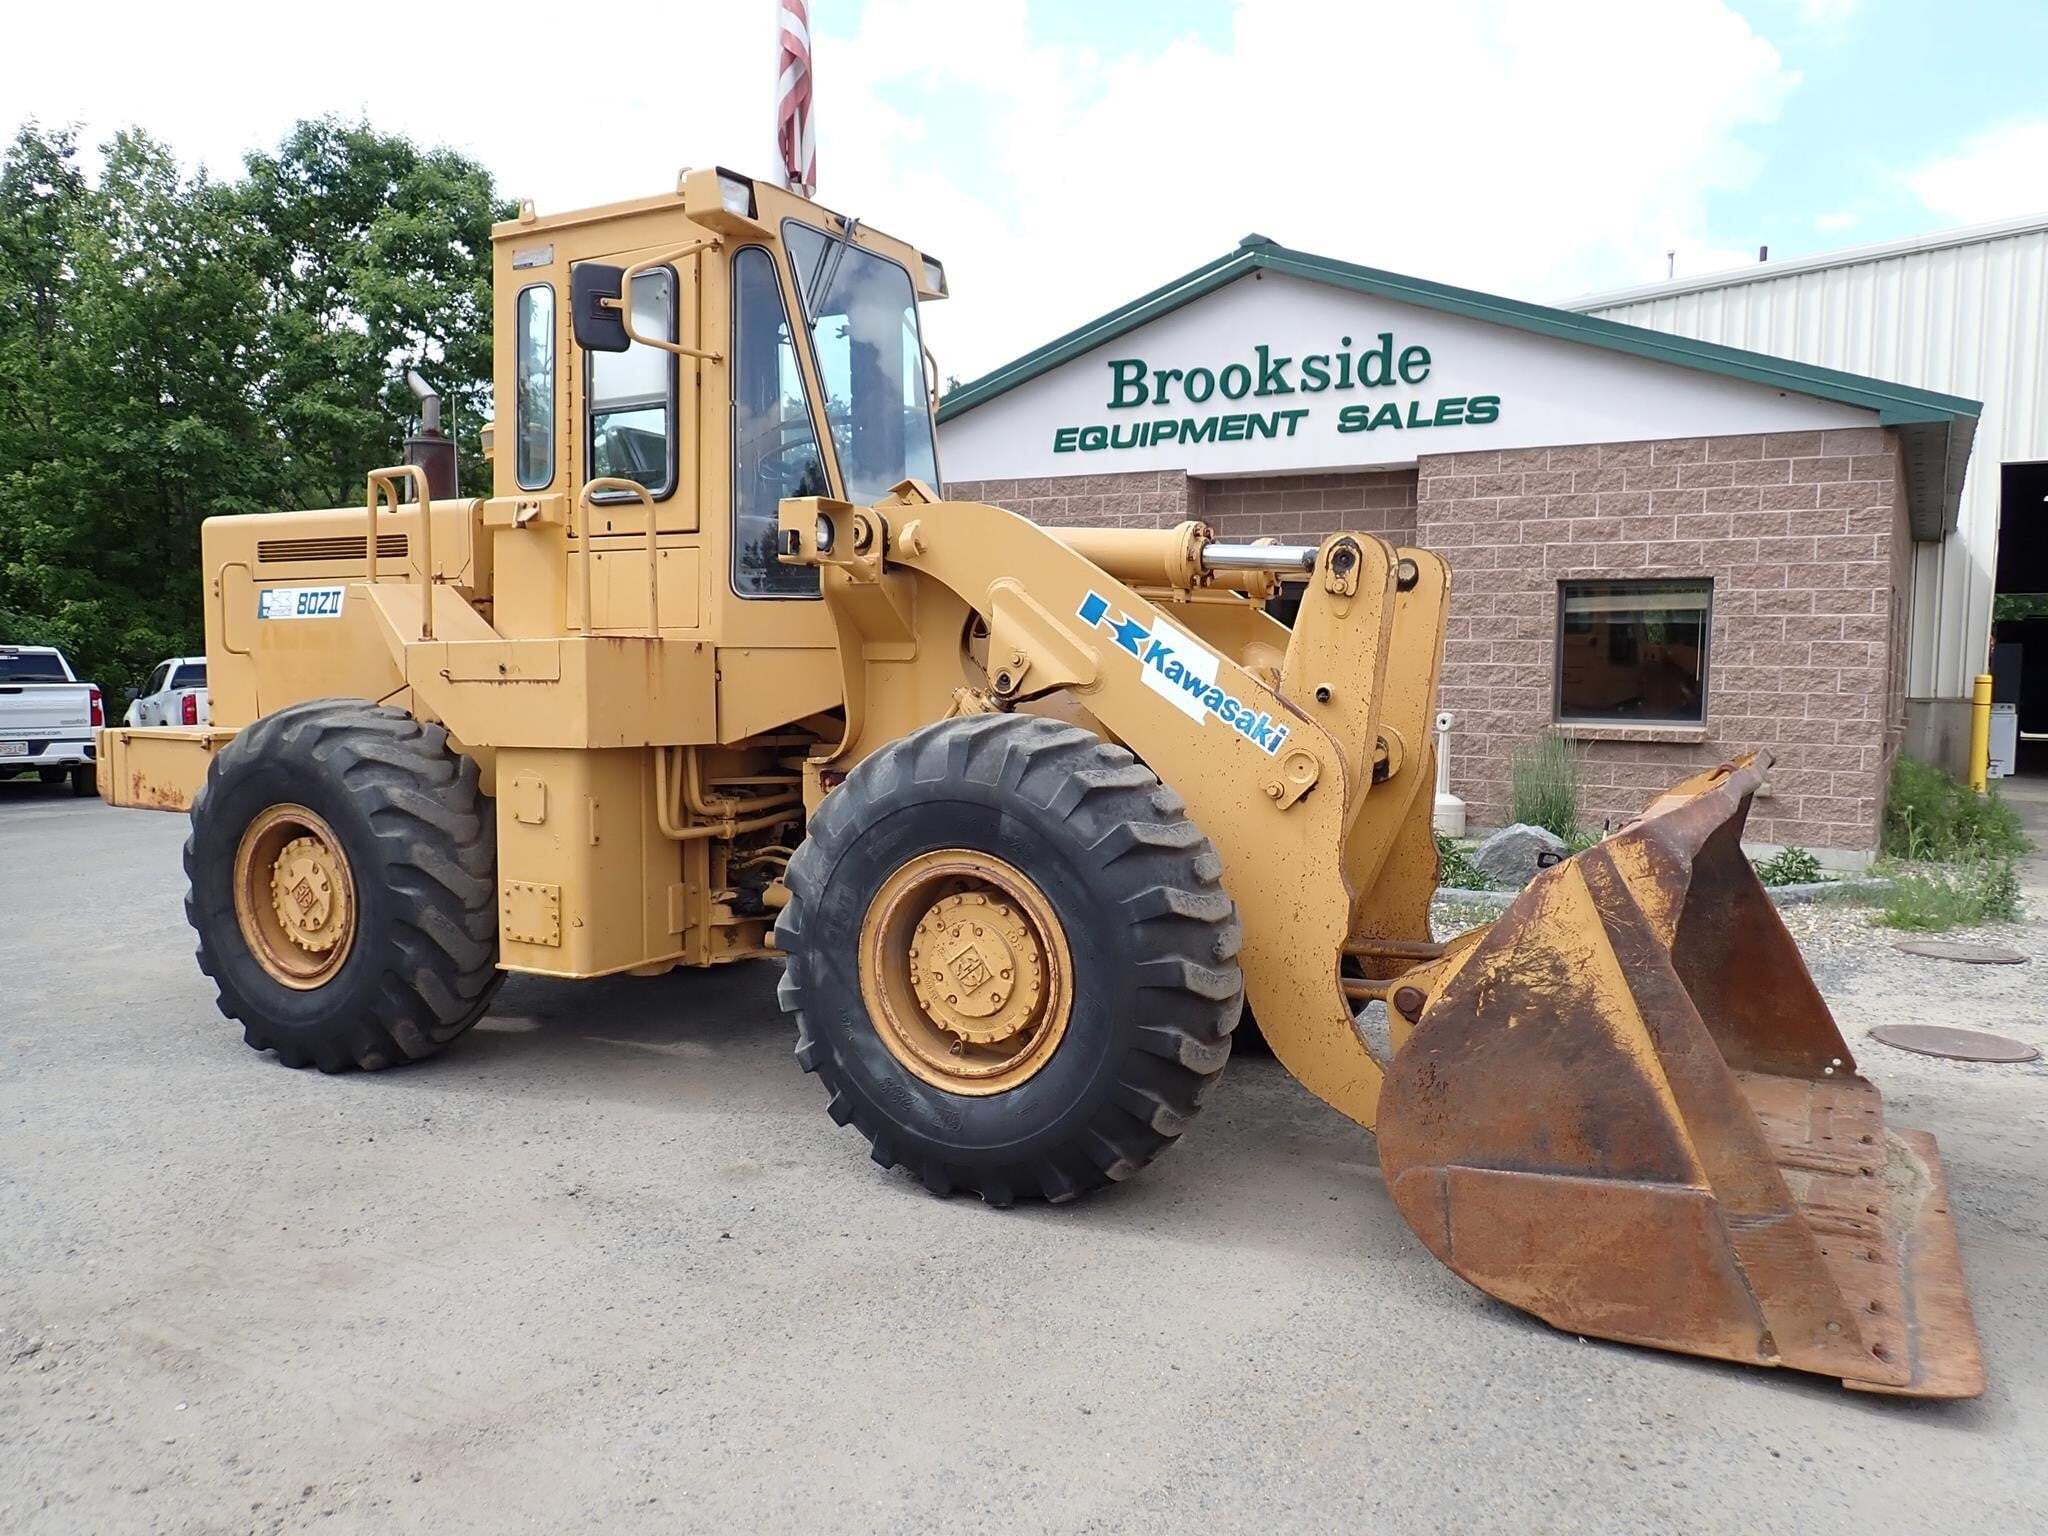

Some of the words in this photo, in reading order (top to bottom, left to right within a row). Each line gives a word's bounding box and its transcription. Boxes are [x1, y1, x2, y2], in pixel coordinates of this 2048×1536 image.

[1107, 333, 1431, 409] Brookside
[1053, 409, 1309, 453] EQUIPMENT
[1337, 395, 1500, 433] SALES
[1144, 640, 1288, 753] Kawasaki
